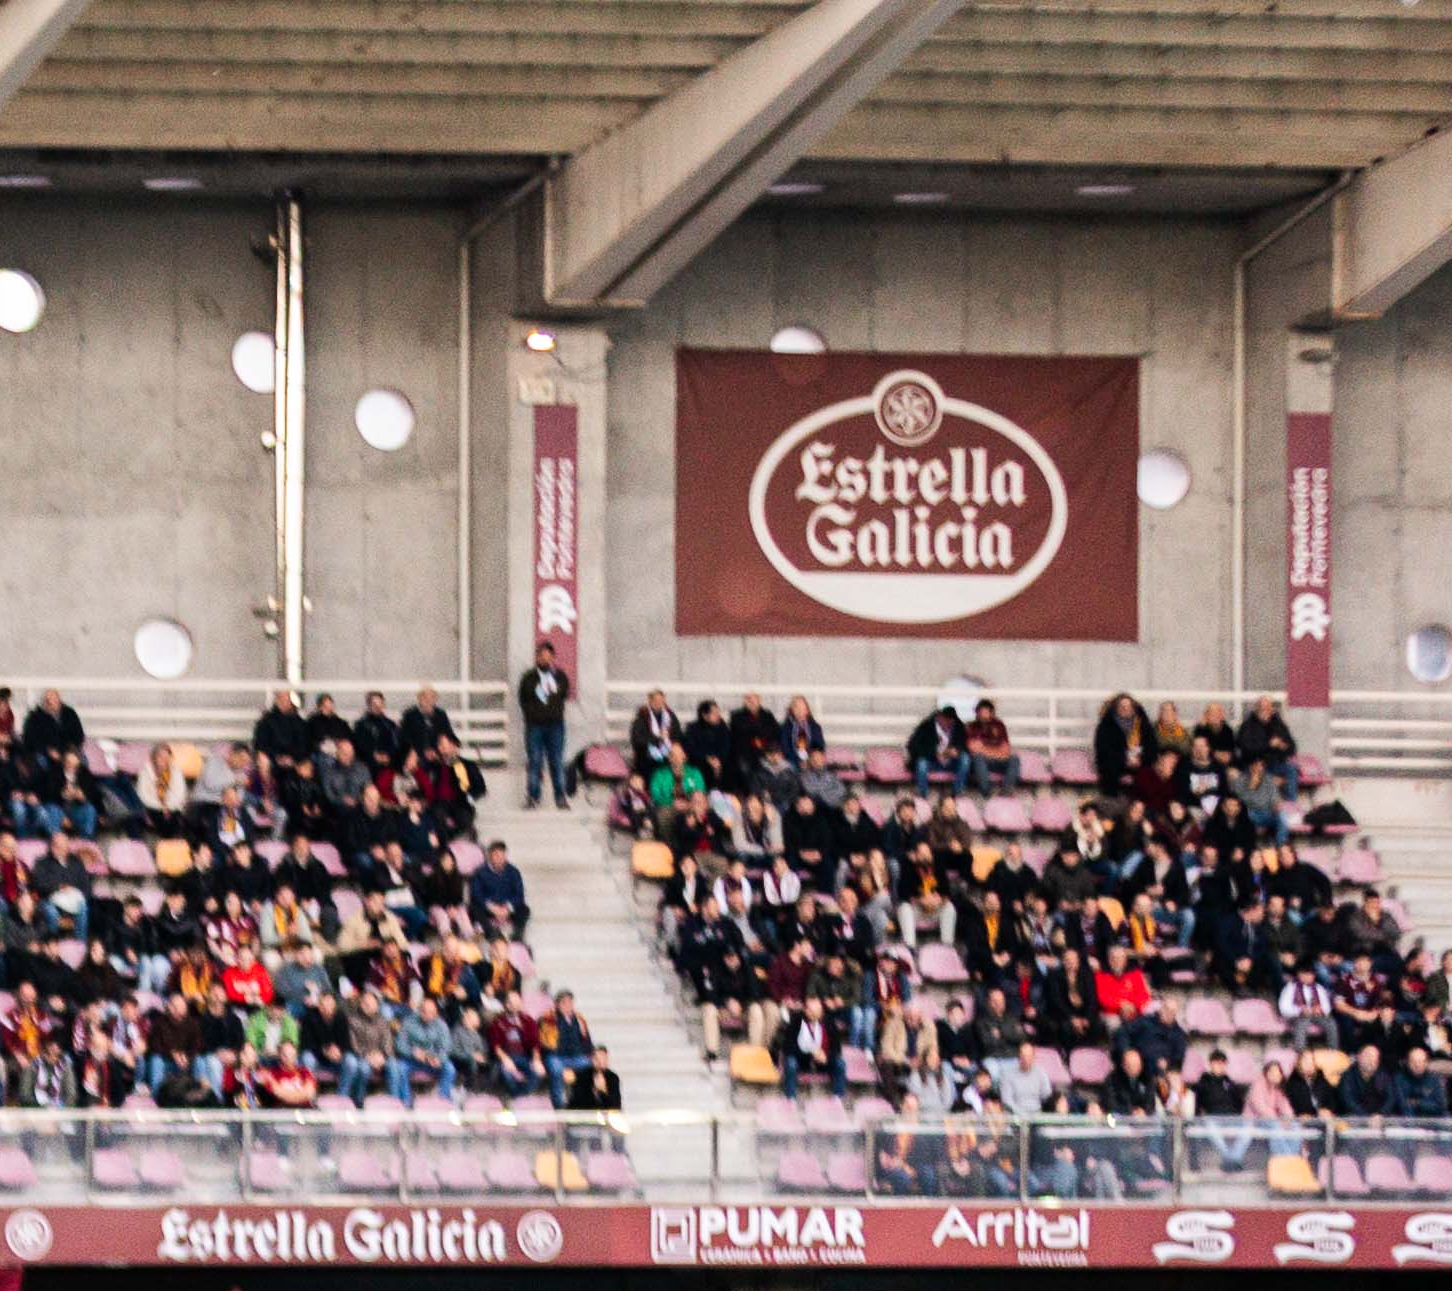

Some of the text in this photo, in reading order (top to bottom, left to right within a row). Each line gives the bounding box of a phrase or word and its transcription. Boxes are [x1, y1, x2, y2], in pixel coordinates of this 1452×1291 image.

[794, 440, 1027, 506] Estrella
[806, 503, 1015, 569] Galicia
[157, 1208, 507, 1263] Estrella Galicia
[700, 1207, 865, 1246] PUMAR
